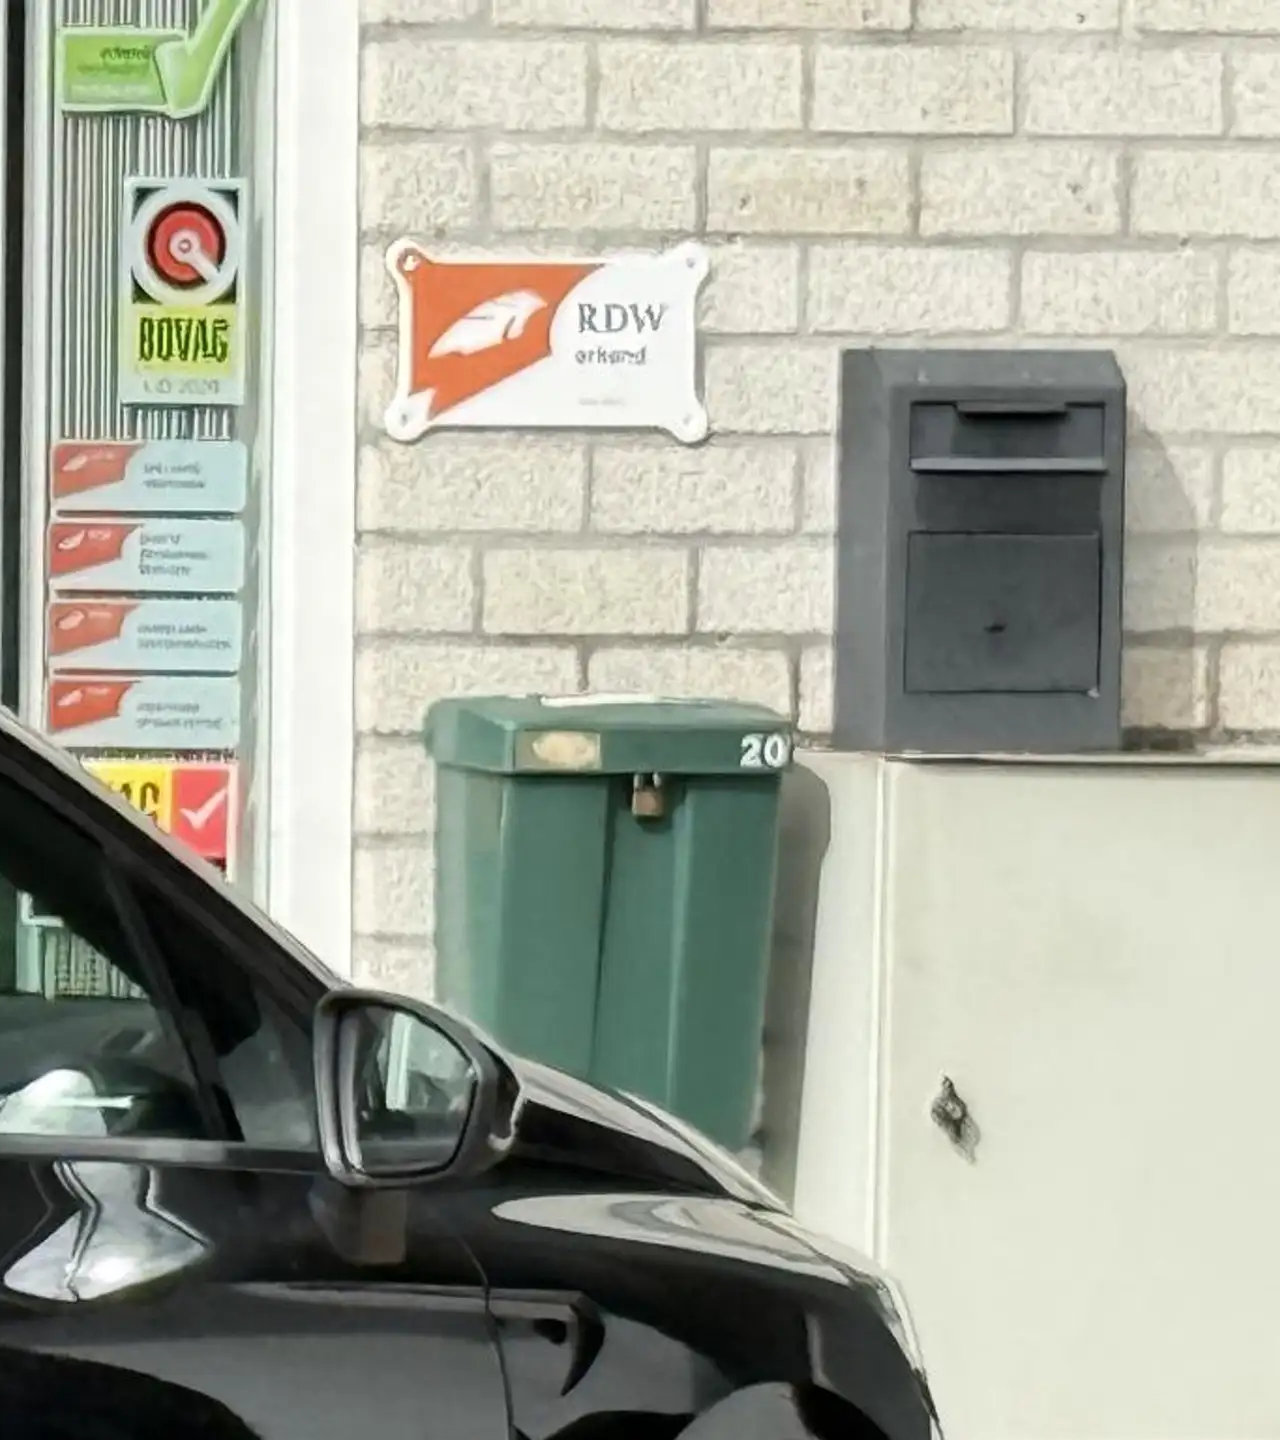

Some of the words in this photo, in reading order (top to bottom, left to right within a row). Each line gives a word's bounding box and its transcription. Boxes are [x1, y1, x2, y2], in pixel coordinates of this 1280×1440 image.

[577, 302, 670, 334] RDW
[139, 316, 230, 363] BOVAG
[739, 732, 787, 768] 20
